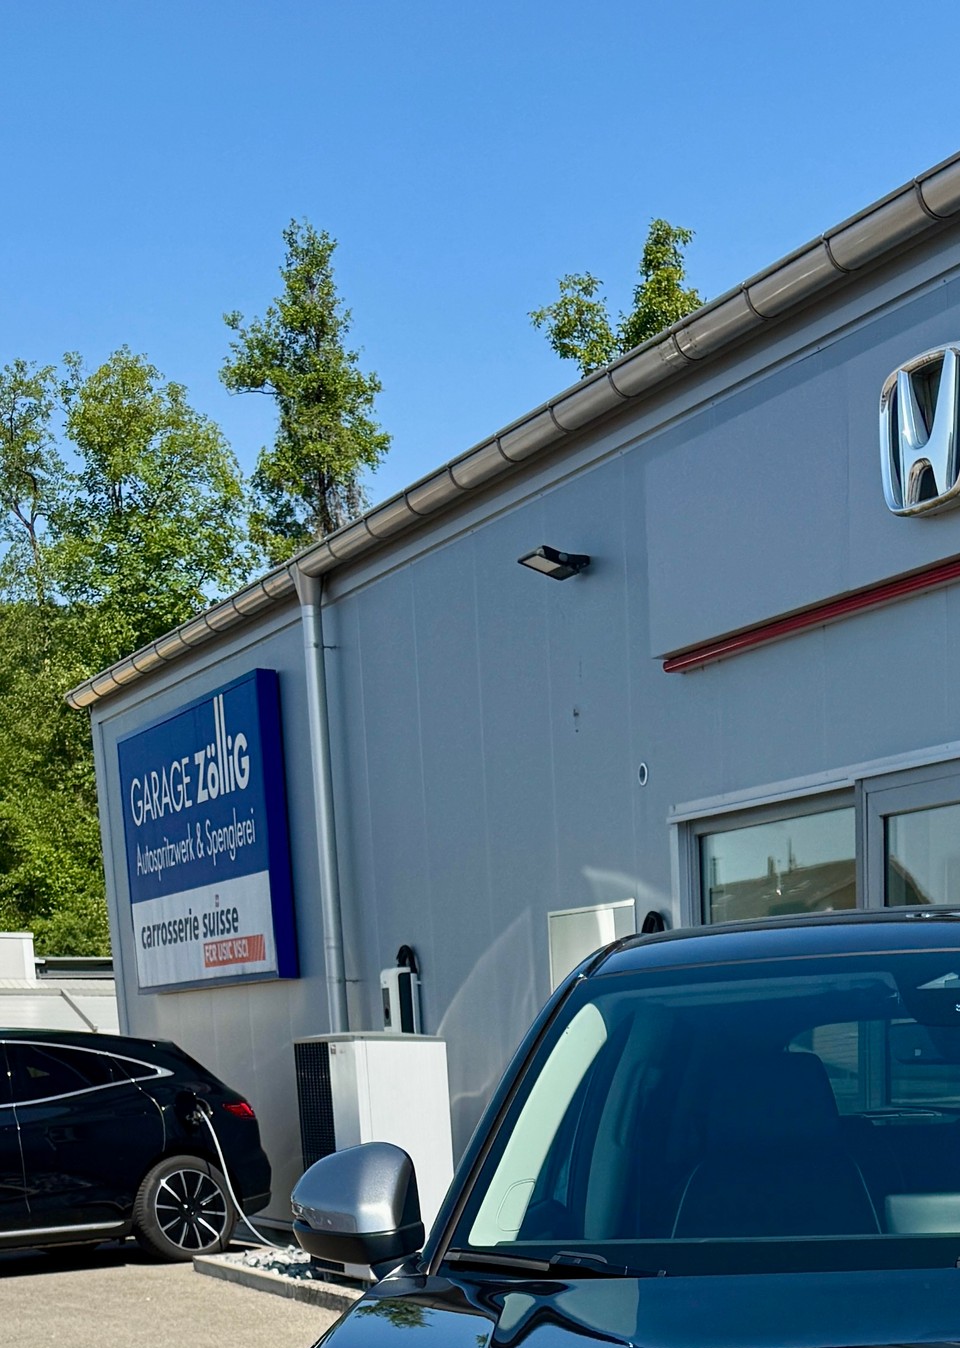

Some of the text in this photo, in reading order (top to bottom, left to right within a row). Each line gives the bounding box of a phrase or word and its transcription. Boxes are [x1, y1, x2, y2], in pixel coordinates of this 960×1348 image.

[130, 756, 192, 827] GARAGE
[136, 807, 256, 882] Autospritzwerk & Spenglerei
[141, 906, 239, 949] carrosserie suisse
